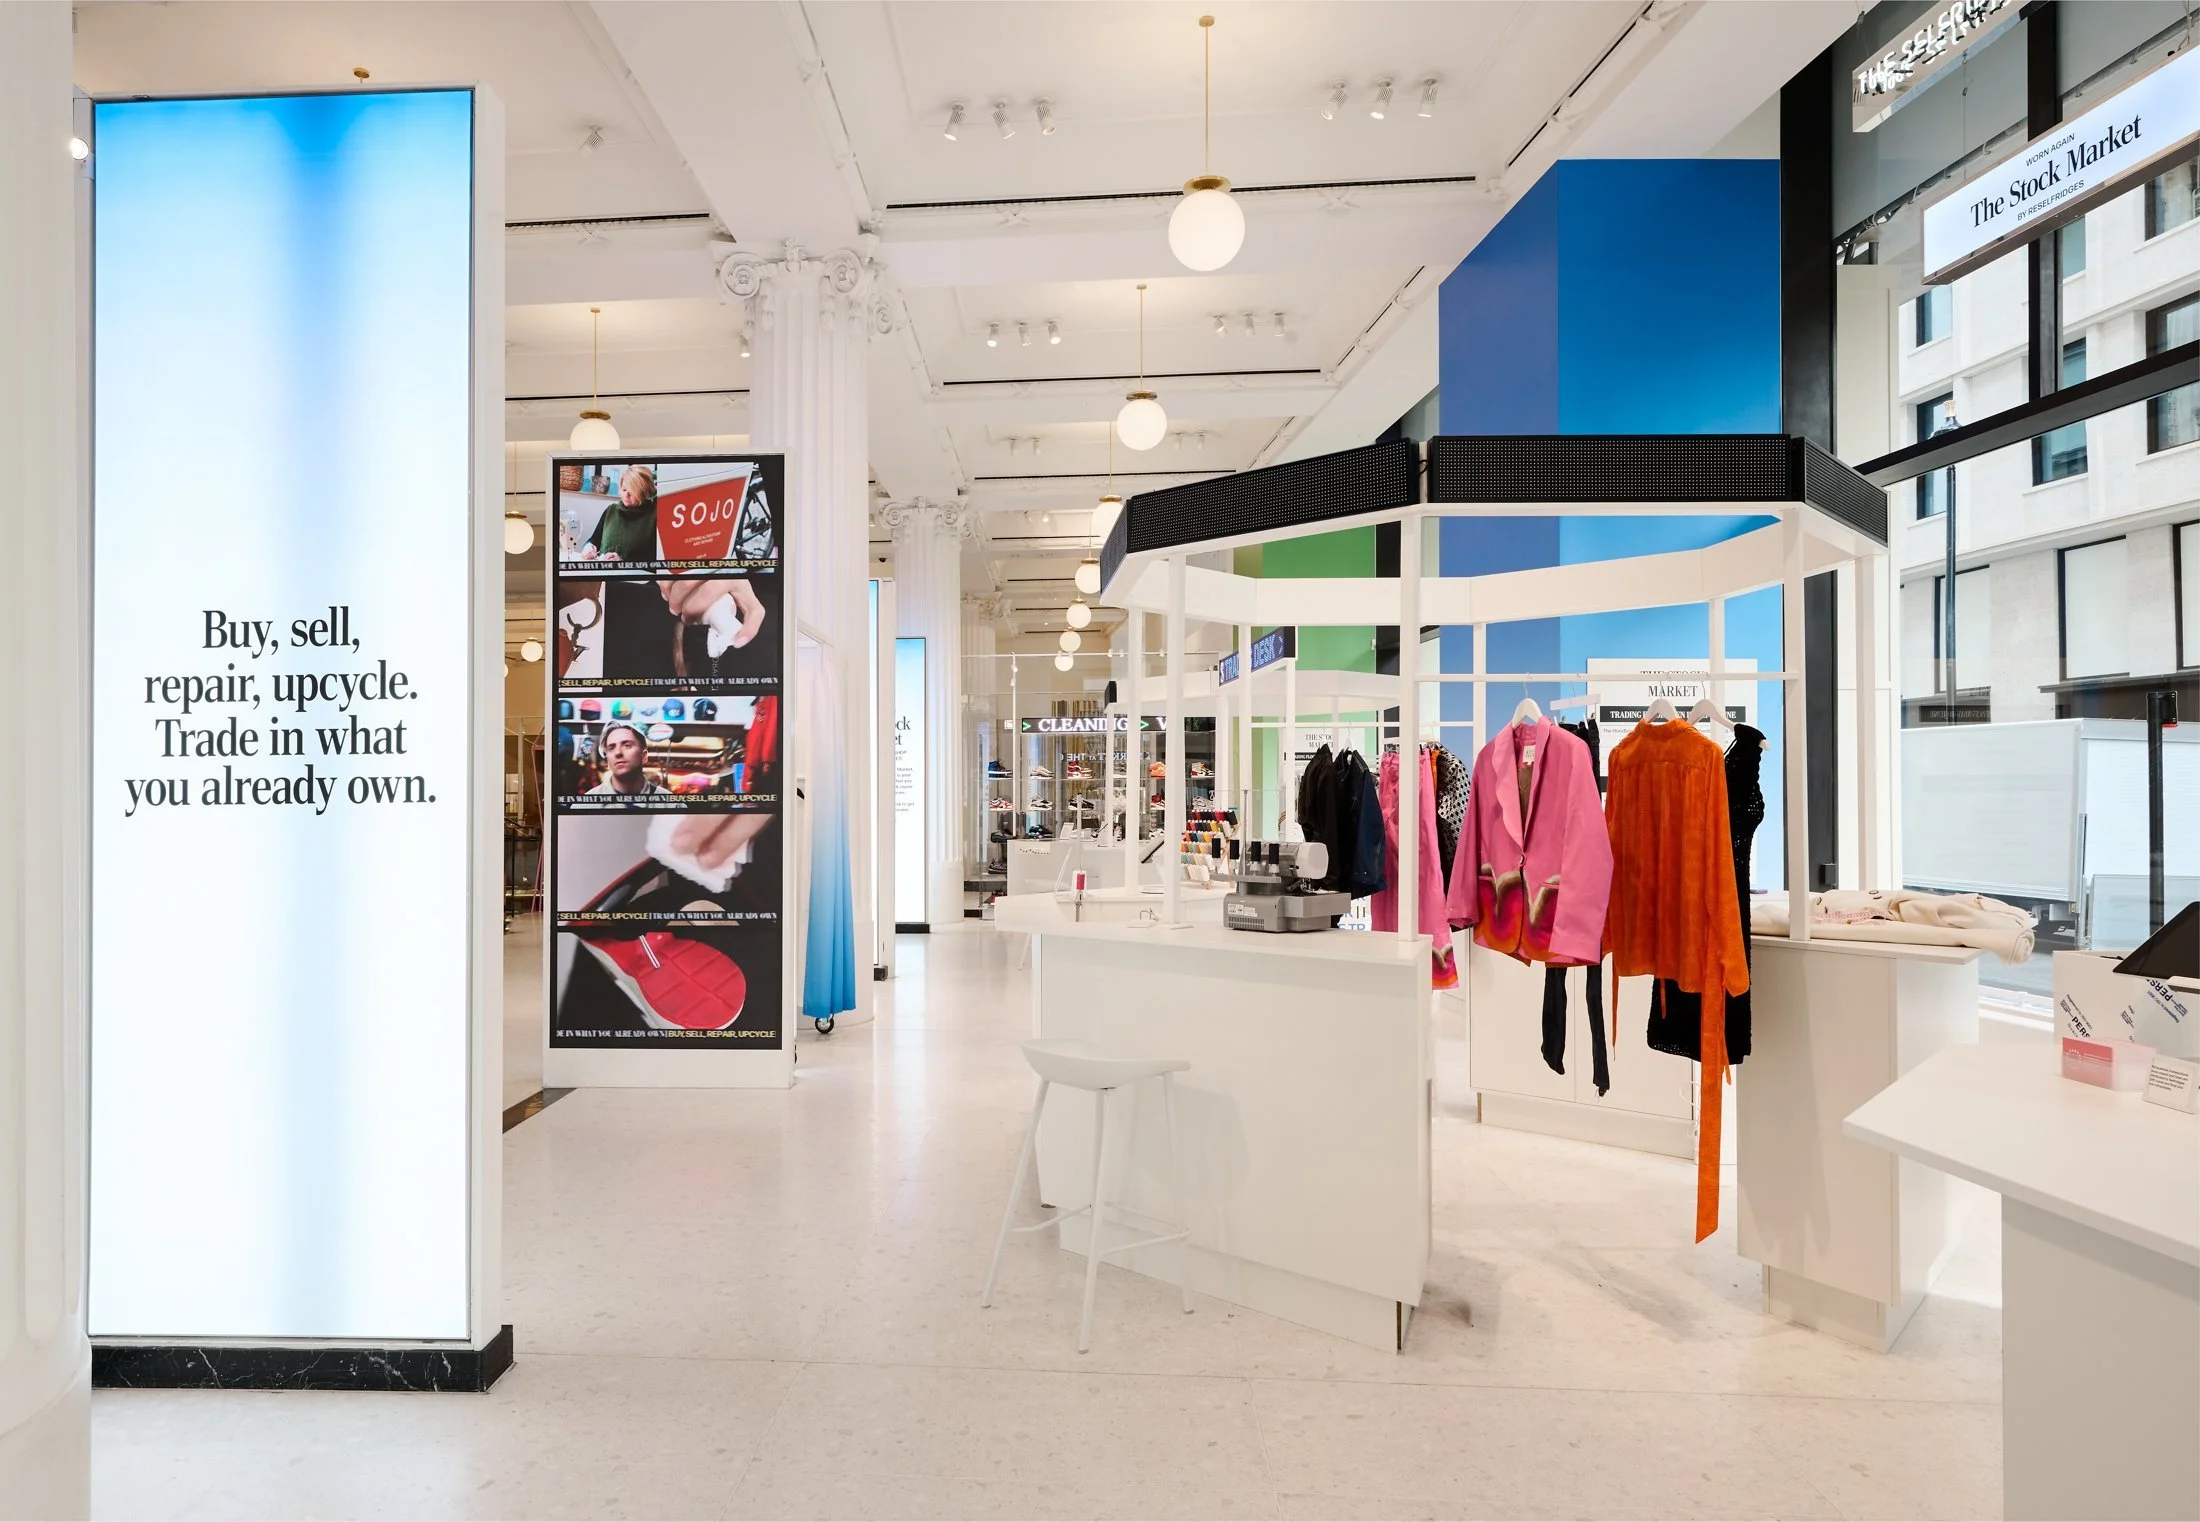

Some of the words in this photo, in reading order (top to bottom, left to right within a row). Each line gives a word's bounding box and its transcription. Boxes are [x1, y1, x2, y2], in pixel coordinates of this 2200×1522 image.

[2025, 147, 2050, 167] WORN
[2050, 132, 2075, 153] AGAIN
[1970, 196, 2004, 228] The
[2009, 160, 2061, 208] Stock
[2066, 114, 2142, 177] Market
[2017, 209, 2028, 221] BY
[2028, 179, 2085, 214] RESELFRIDGES
[671, 498, 734, 529] SOJO
[709, 560, 739, 568] REPAIR,
[202, 609, 279, 659] Buy,
[290, 606, 360, 654] sell,
[1254, 634, 1276, 668] DESK
[144, 662, 261, 714] repair,
[272, 659, 418, 713] upcycle.
[1648, 685, 1698, 697] MARKET
[1610, 710, 1642, 719] TRADING
[155, 716, 259, 757] Trade
[269, 716, 305, 756] in
[315, 714, 407, 756] what
[124, 777, 191, 817] you
[201, 763, 337, 816] already
[348, 775, 436, 804] own.
[739, 794, 777, 802] UPCYCLE
[581, 912, 611, 920] REPAIR,
